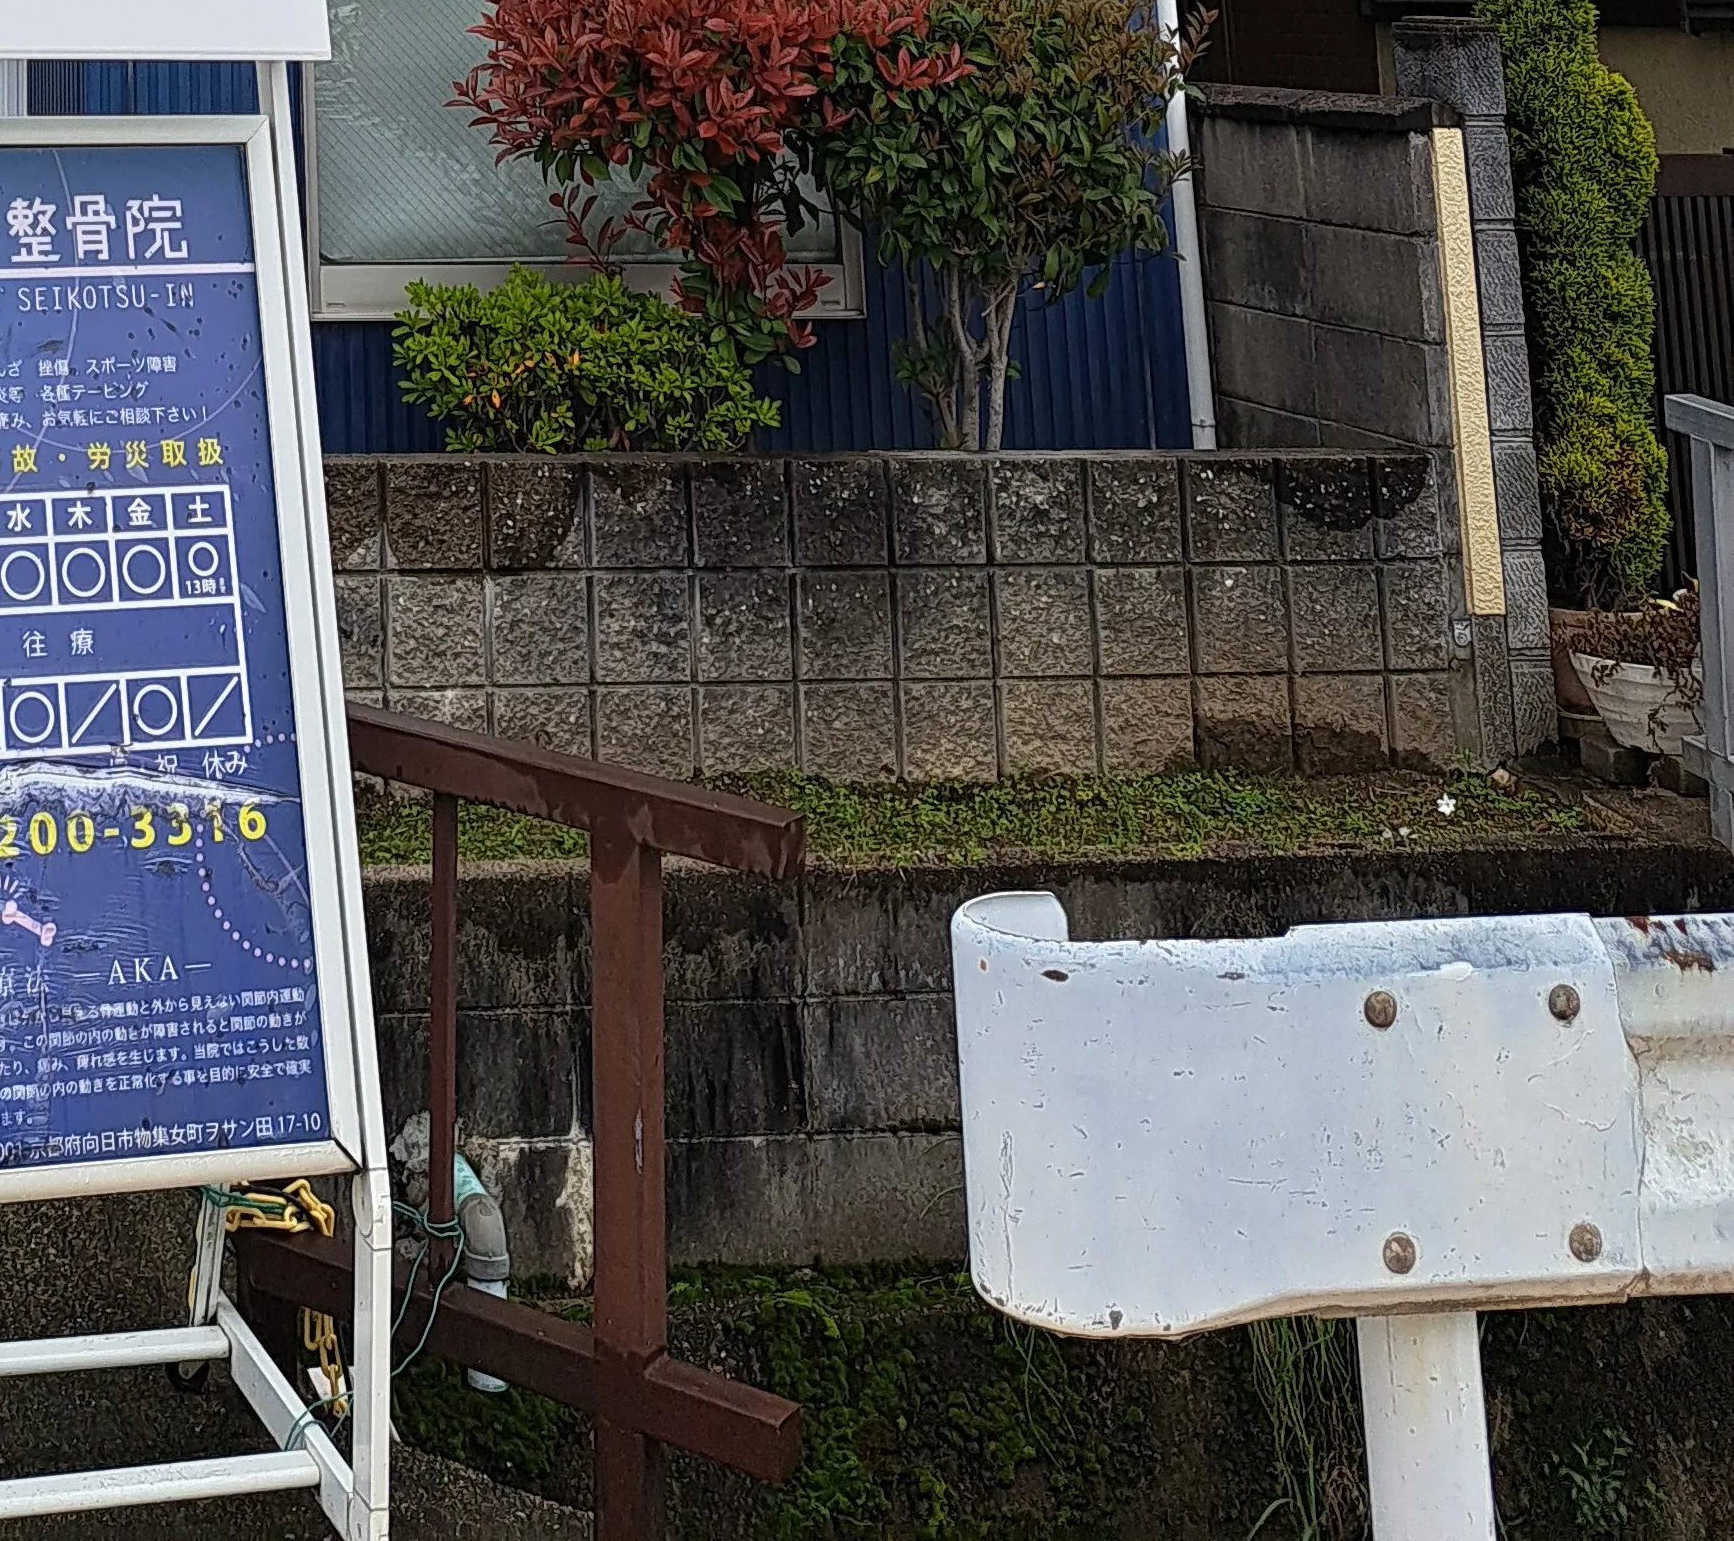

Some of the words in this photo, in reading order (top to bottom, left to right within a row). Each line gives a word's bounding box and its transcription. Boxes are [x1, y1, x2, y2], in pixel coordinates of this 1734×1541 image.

[18, 282, 196, 314] SEIKOTSU-IN
[86, 356, 177, 376] スポーツ障害
[40, 381, 149, 403] 各種テーピング
[6, 504, 33, 532] 水
[67, 501, 94, 528] 木
[126, 497, 154, 527] 金
[188, 495, 213, 523] 土
[22, 627, 95, 659] 往療
[202, 750, 248, 780] 休み
